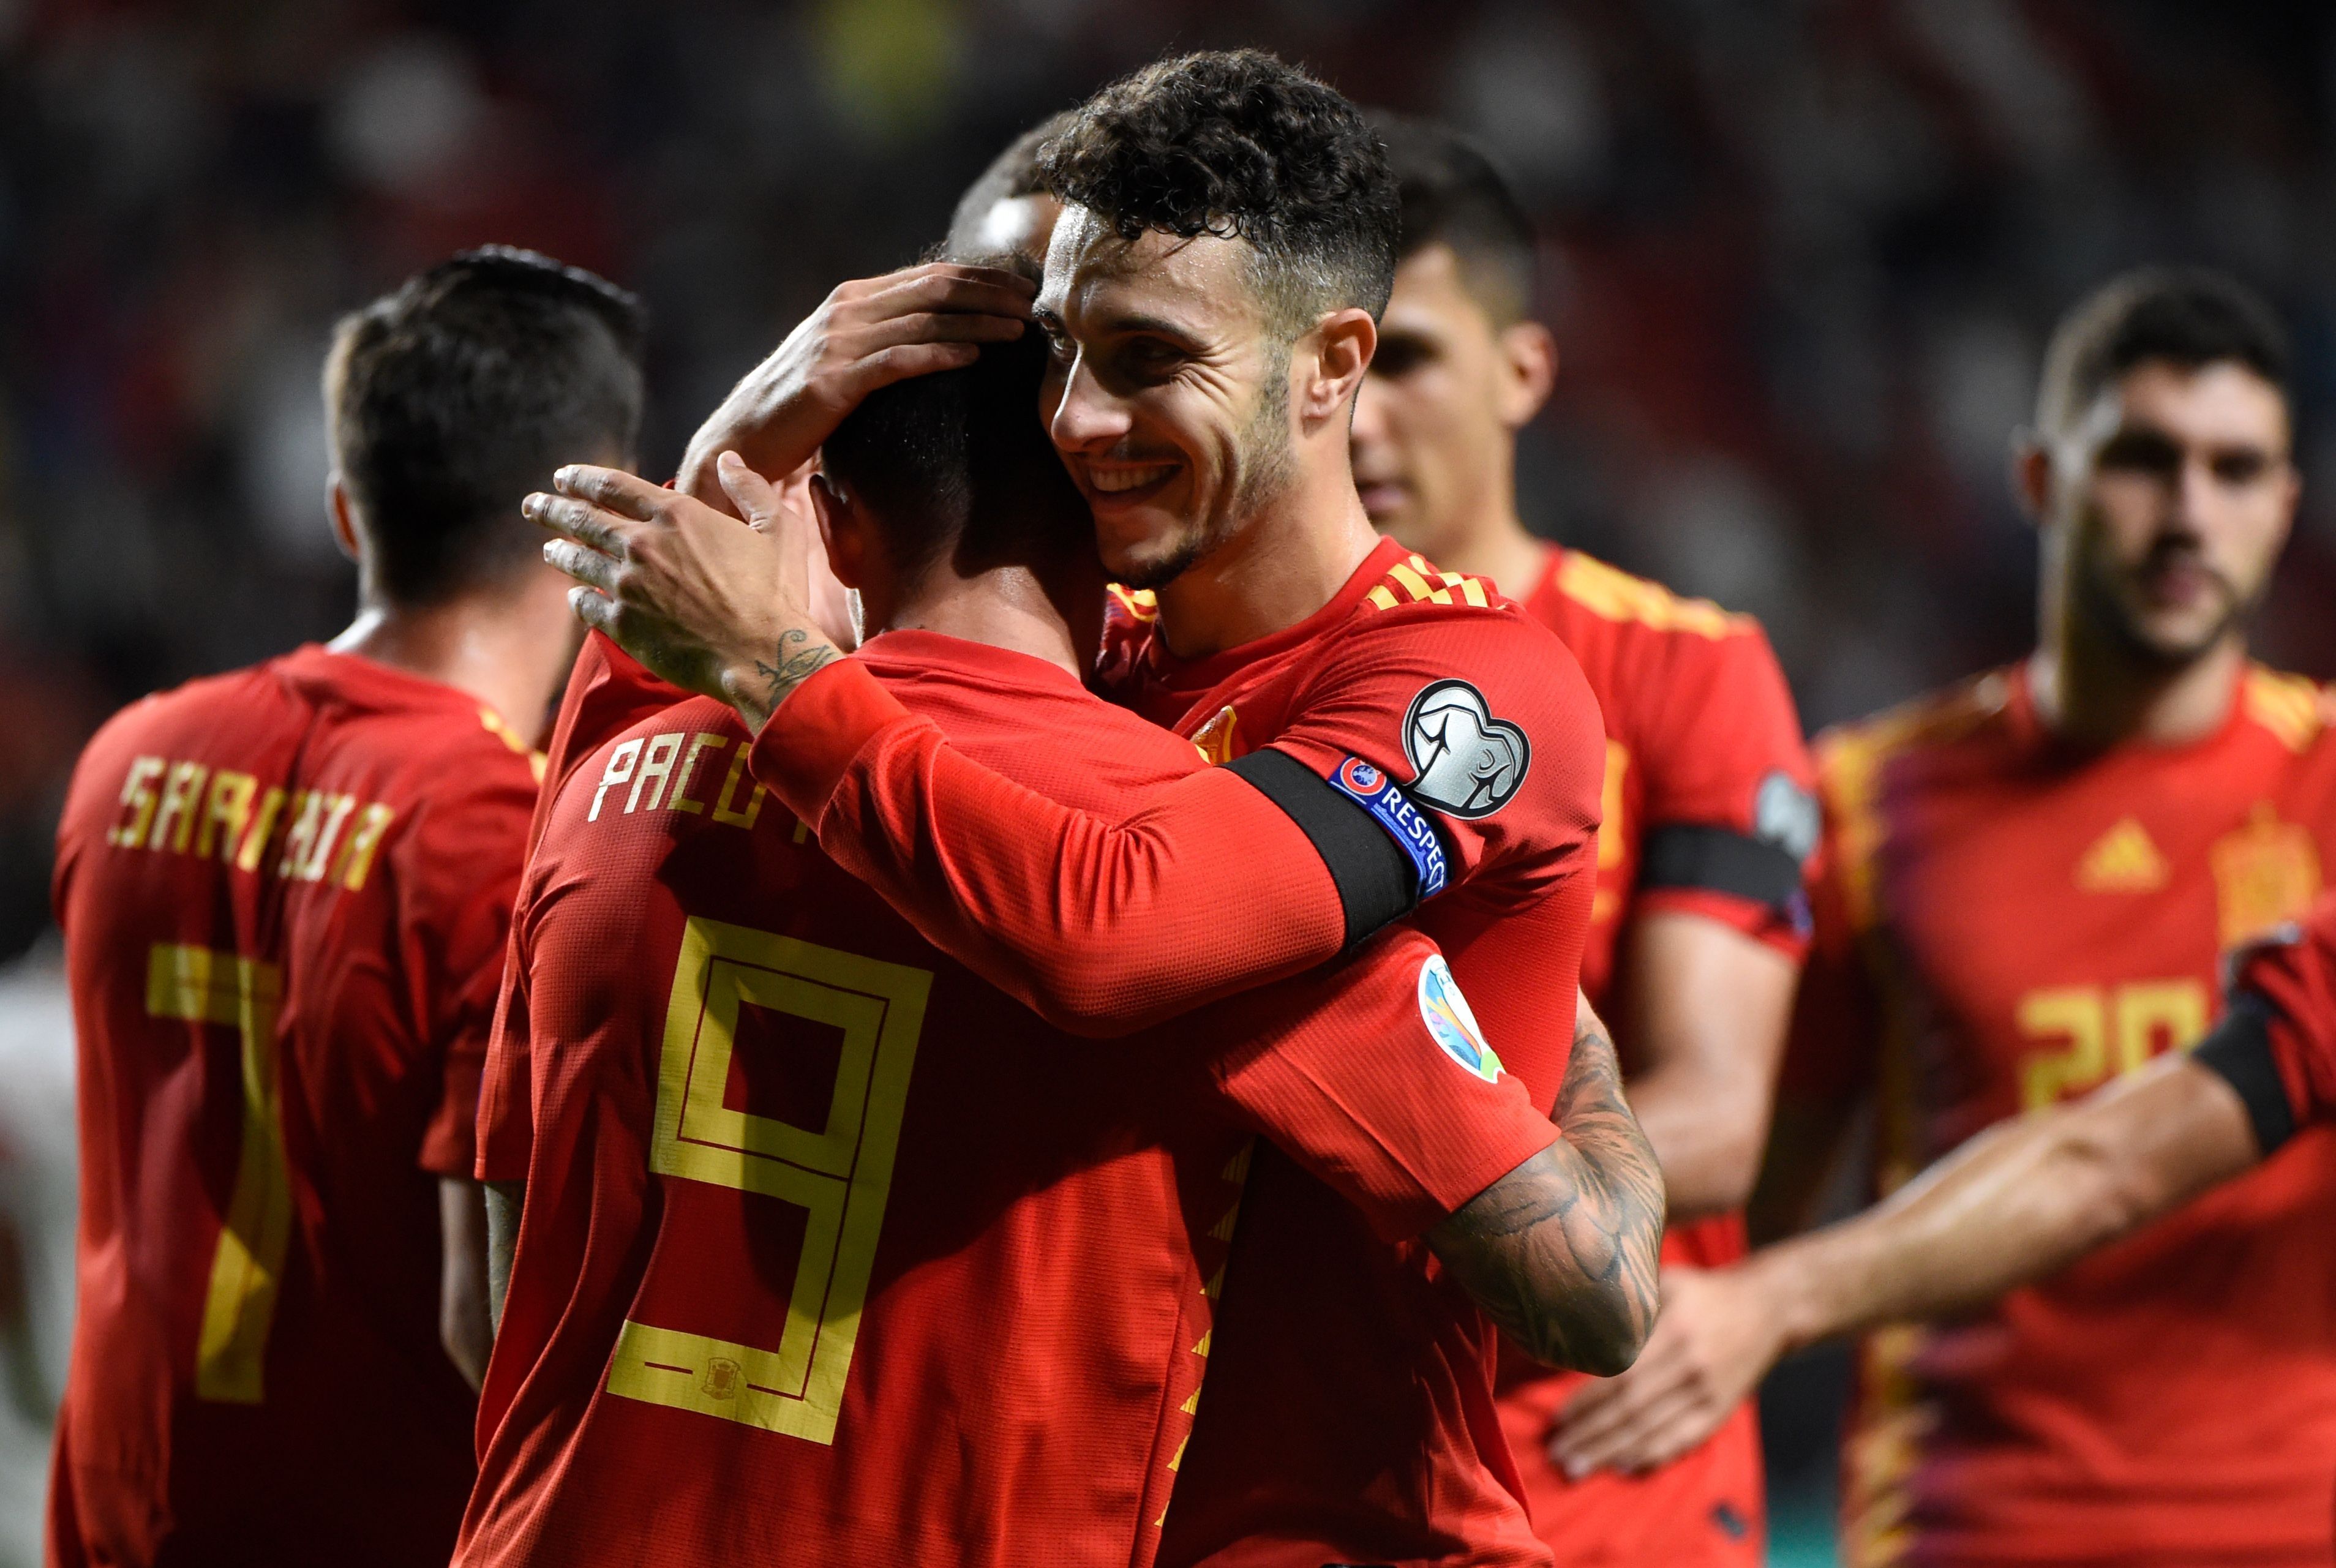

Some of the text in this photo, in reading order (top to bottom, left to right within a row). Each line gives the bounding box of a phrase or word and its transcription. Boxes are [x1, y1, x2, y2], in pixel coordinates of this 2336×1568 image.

[588, 732, 767, 830] PACO
[1382, 786, 1444, 893] RESPECT
[146, 942, 293, 1405] 7
[606, 915, 934, 1446] 9
